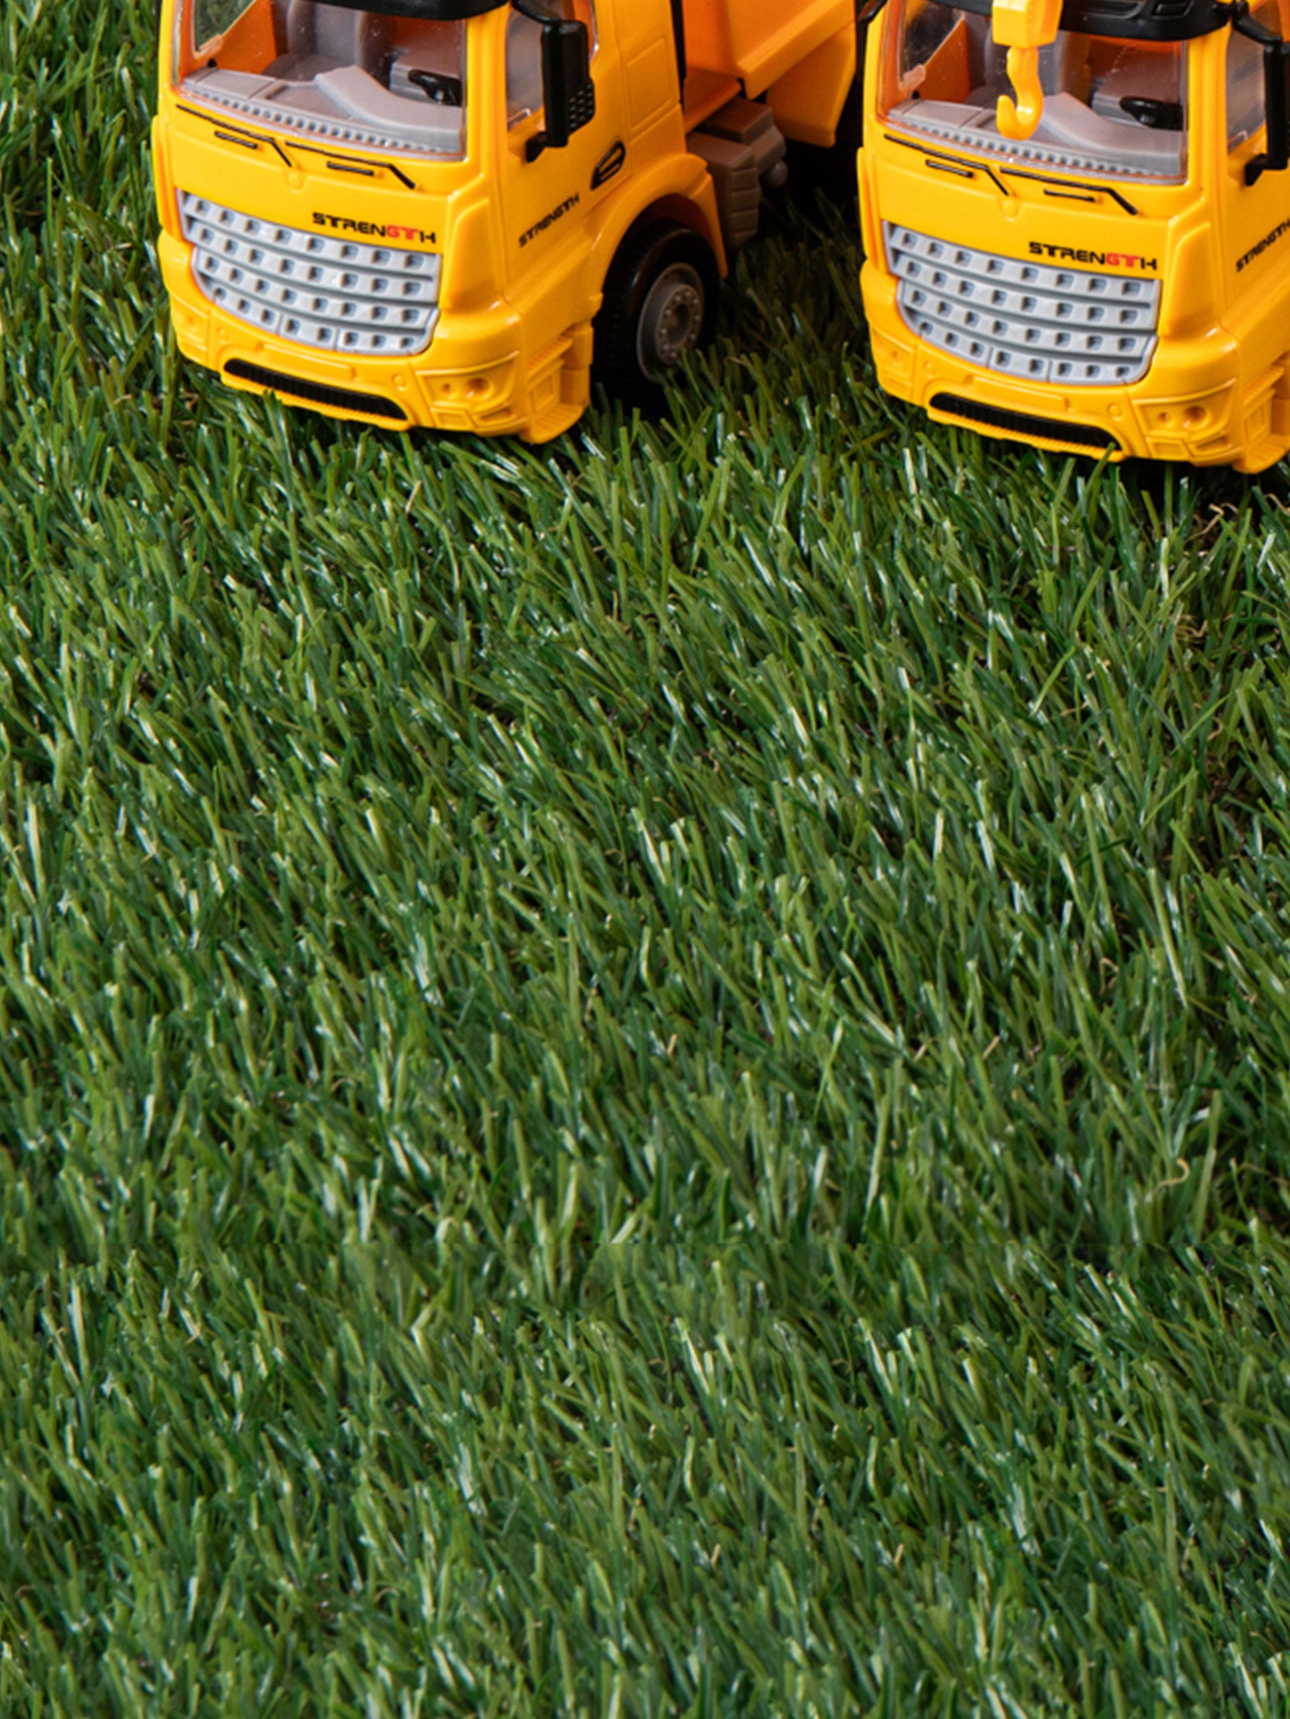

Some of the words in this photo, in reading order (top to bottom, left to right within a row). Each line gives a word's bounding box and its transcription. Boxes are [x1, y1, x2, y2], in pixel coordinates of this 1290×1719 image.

[312, 211, 437, 244] STRENGTH
[518, 192, 580, 248] STRENGTH
[1028, 241, 1158, 271] STRENGTH
[1235, 218, 1290, 273] STRENGTH
